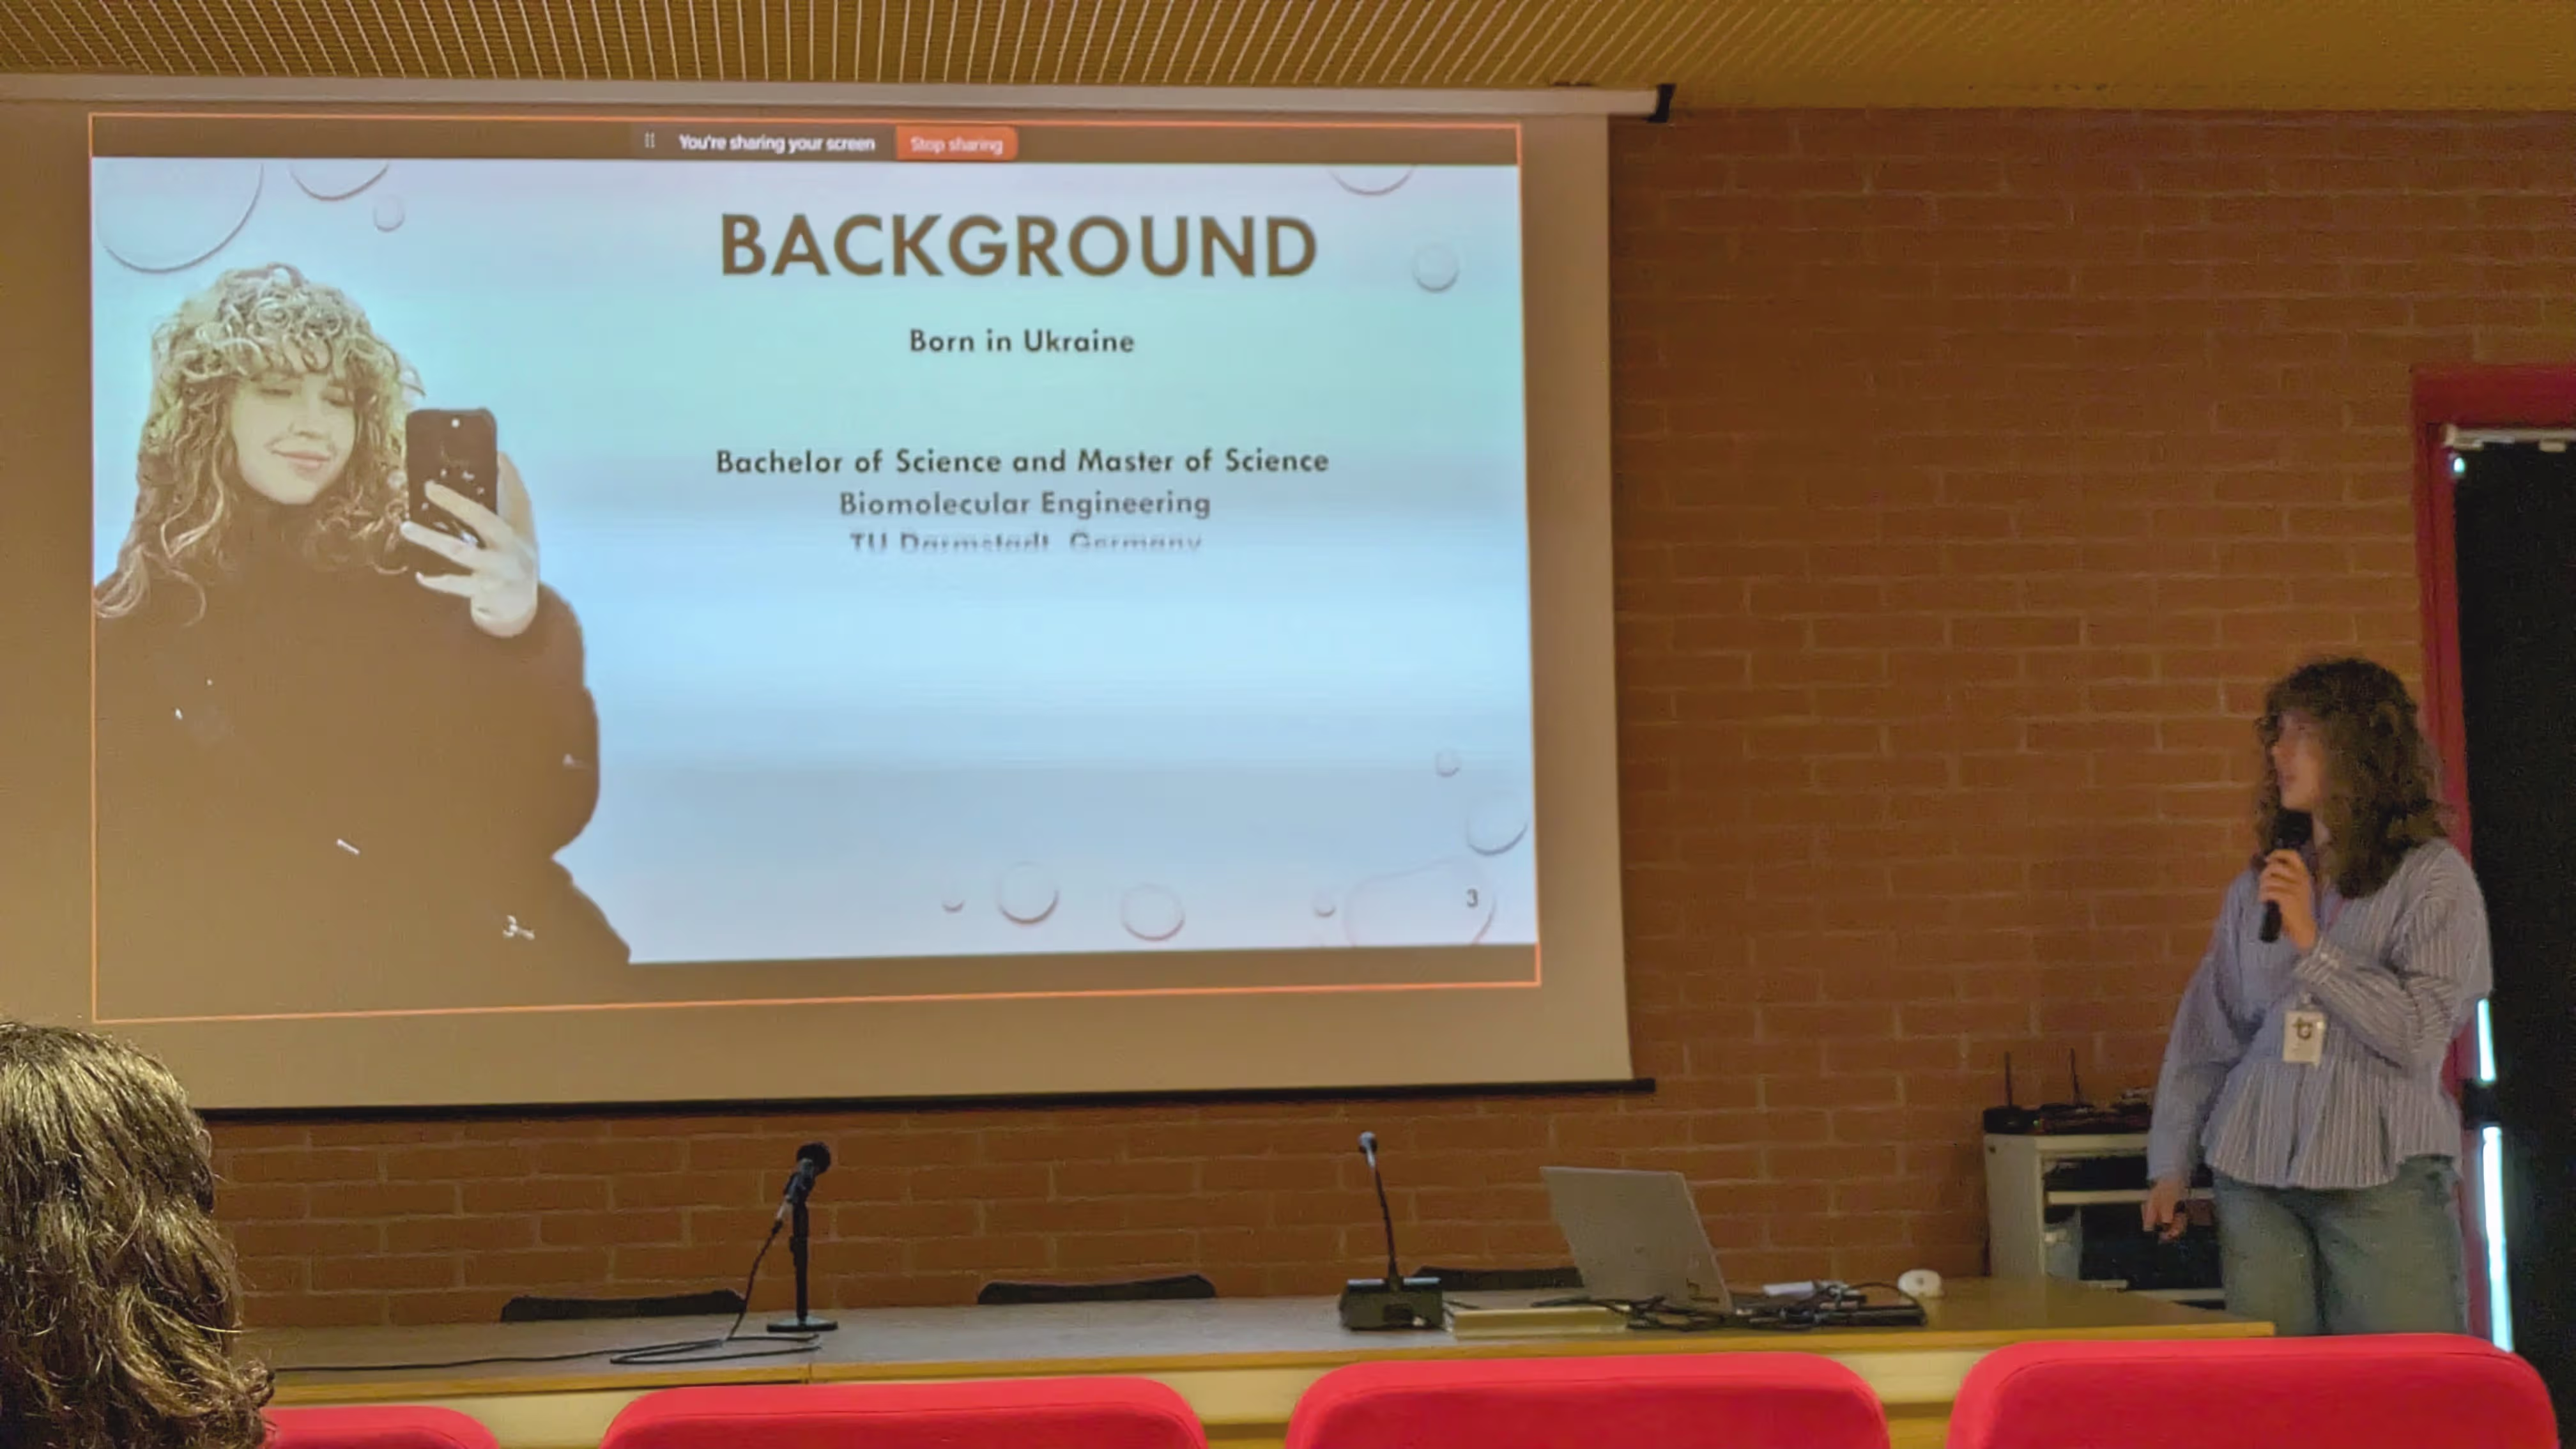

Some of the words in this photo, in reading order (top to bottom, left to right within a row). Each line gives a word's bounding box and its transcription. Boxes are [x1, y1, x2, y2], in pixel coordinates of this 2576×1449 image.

[678, 134, 727, 150] You're
[730, 134, 785, 154] sharing
[788, 137, 824, 154] your
[826, 137, 876, 151] screen
[910, 136, 946, 154] Stop
[948, 136, 1004, 155] sharing
[723, 213, 1317, 277] BACKGROUND
[910, 328, 975, 353] Born
[986, 328, 1012, 352] in
[1023, 328, 1135, 353] Ukraine
[716, 448, 843, 474] Bachelor
[854, 448, 883, 474] of
[896, 447, 1002, 473] Science
[1012, 448, 1066, 473] and
[1078, 447, 1174, 473] Master
[1184, 447, 1213, 473] of
[1225, 447, 1330, 473] Science
[839, 491, 1029, 516] Biomolecular
[1041, 489, 1211, 521] Engineering
[1466, 888, 1478, 908] 3
